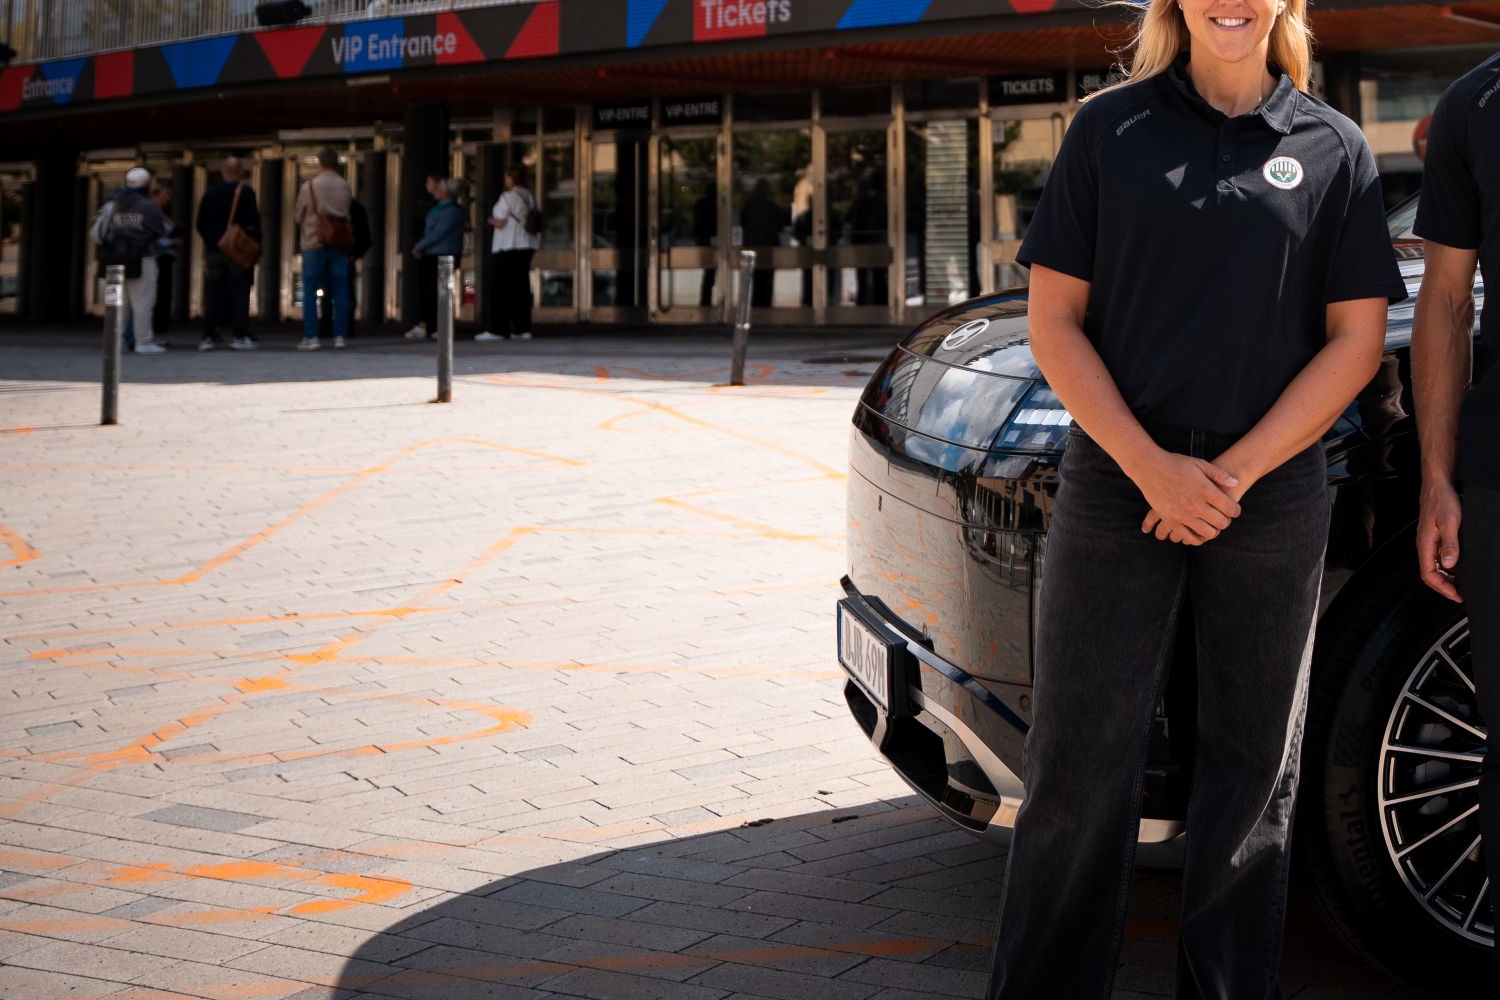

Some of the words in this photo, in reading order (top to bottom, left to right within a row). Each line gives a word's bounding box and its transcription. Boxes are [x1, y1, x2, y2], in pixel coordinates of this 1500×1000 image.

[331, 35, 362, 64] VIP
[368, 32, 457, 60] Entrance
[22, 76, 74, 100] Entrance
[1001, 78, 1054, 95] TICKETS
